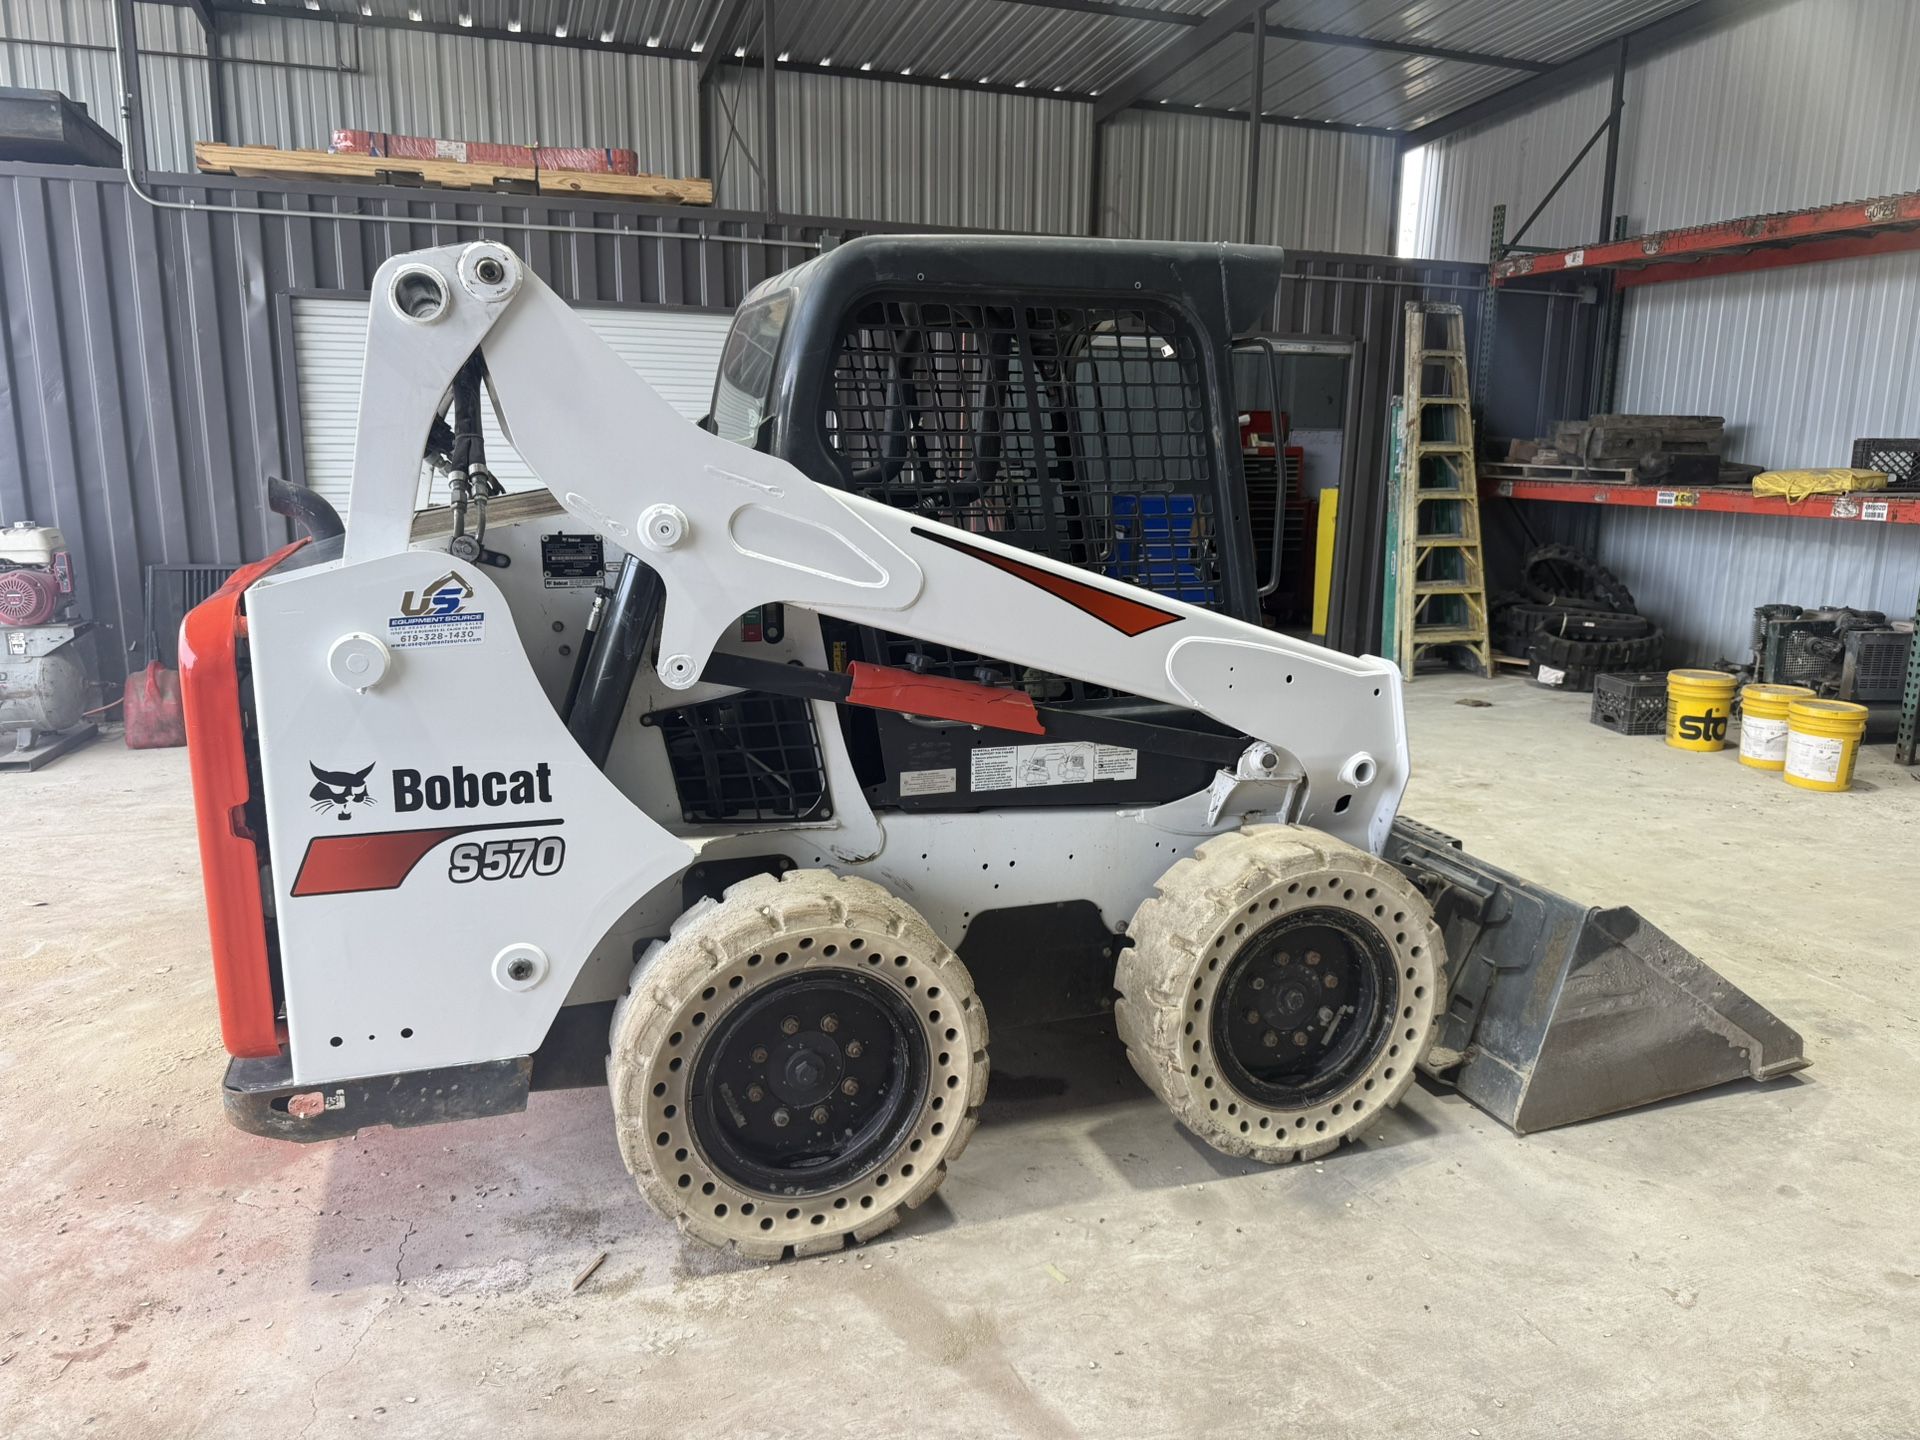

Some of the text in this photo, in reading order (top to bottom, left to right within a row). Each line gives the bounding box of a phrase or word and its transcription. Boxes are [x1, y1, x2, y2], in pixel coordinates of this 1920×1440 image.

[400, 587, 464, 616] US
[391, 613, 482, 626] EQUIPMENT SOURCE
[391, 637, 482, 647] www.usequipmentsource.com
[400, 630, 474, 643] 619-328-1430
[1679, 708, 1728, 741] sto
[392, 762, 553, 813] Bobcat
[448, 836, 566, 884] S570
